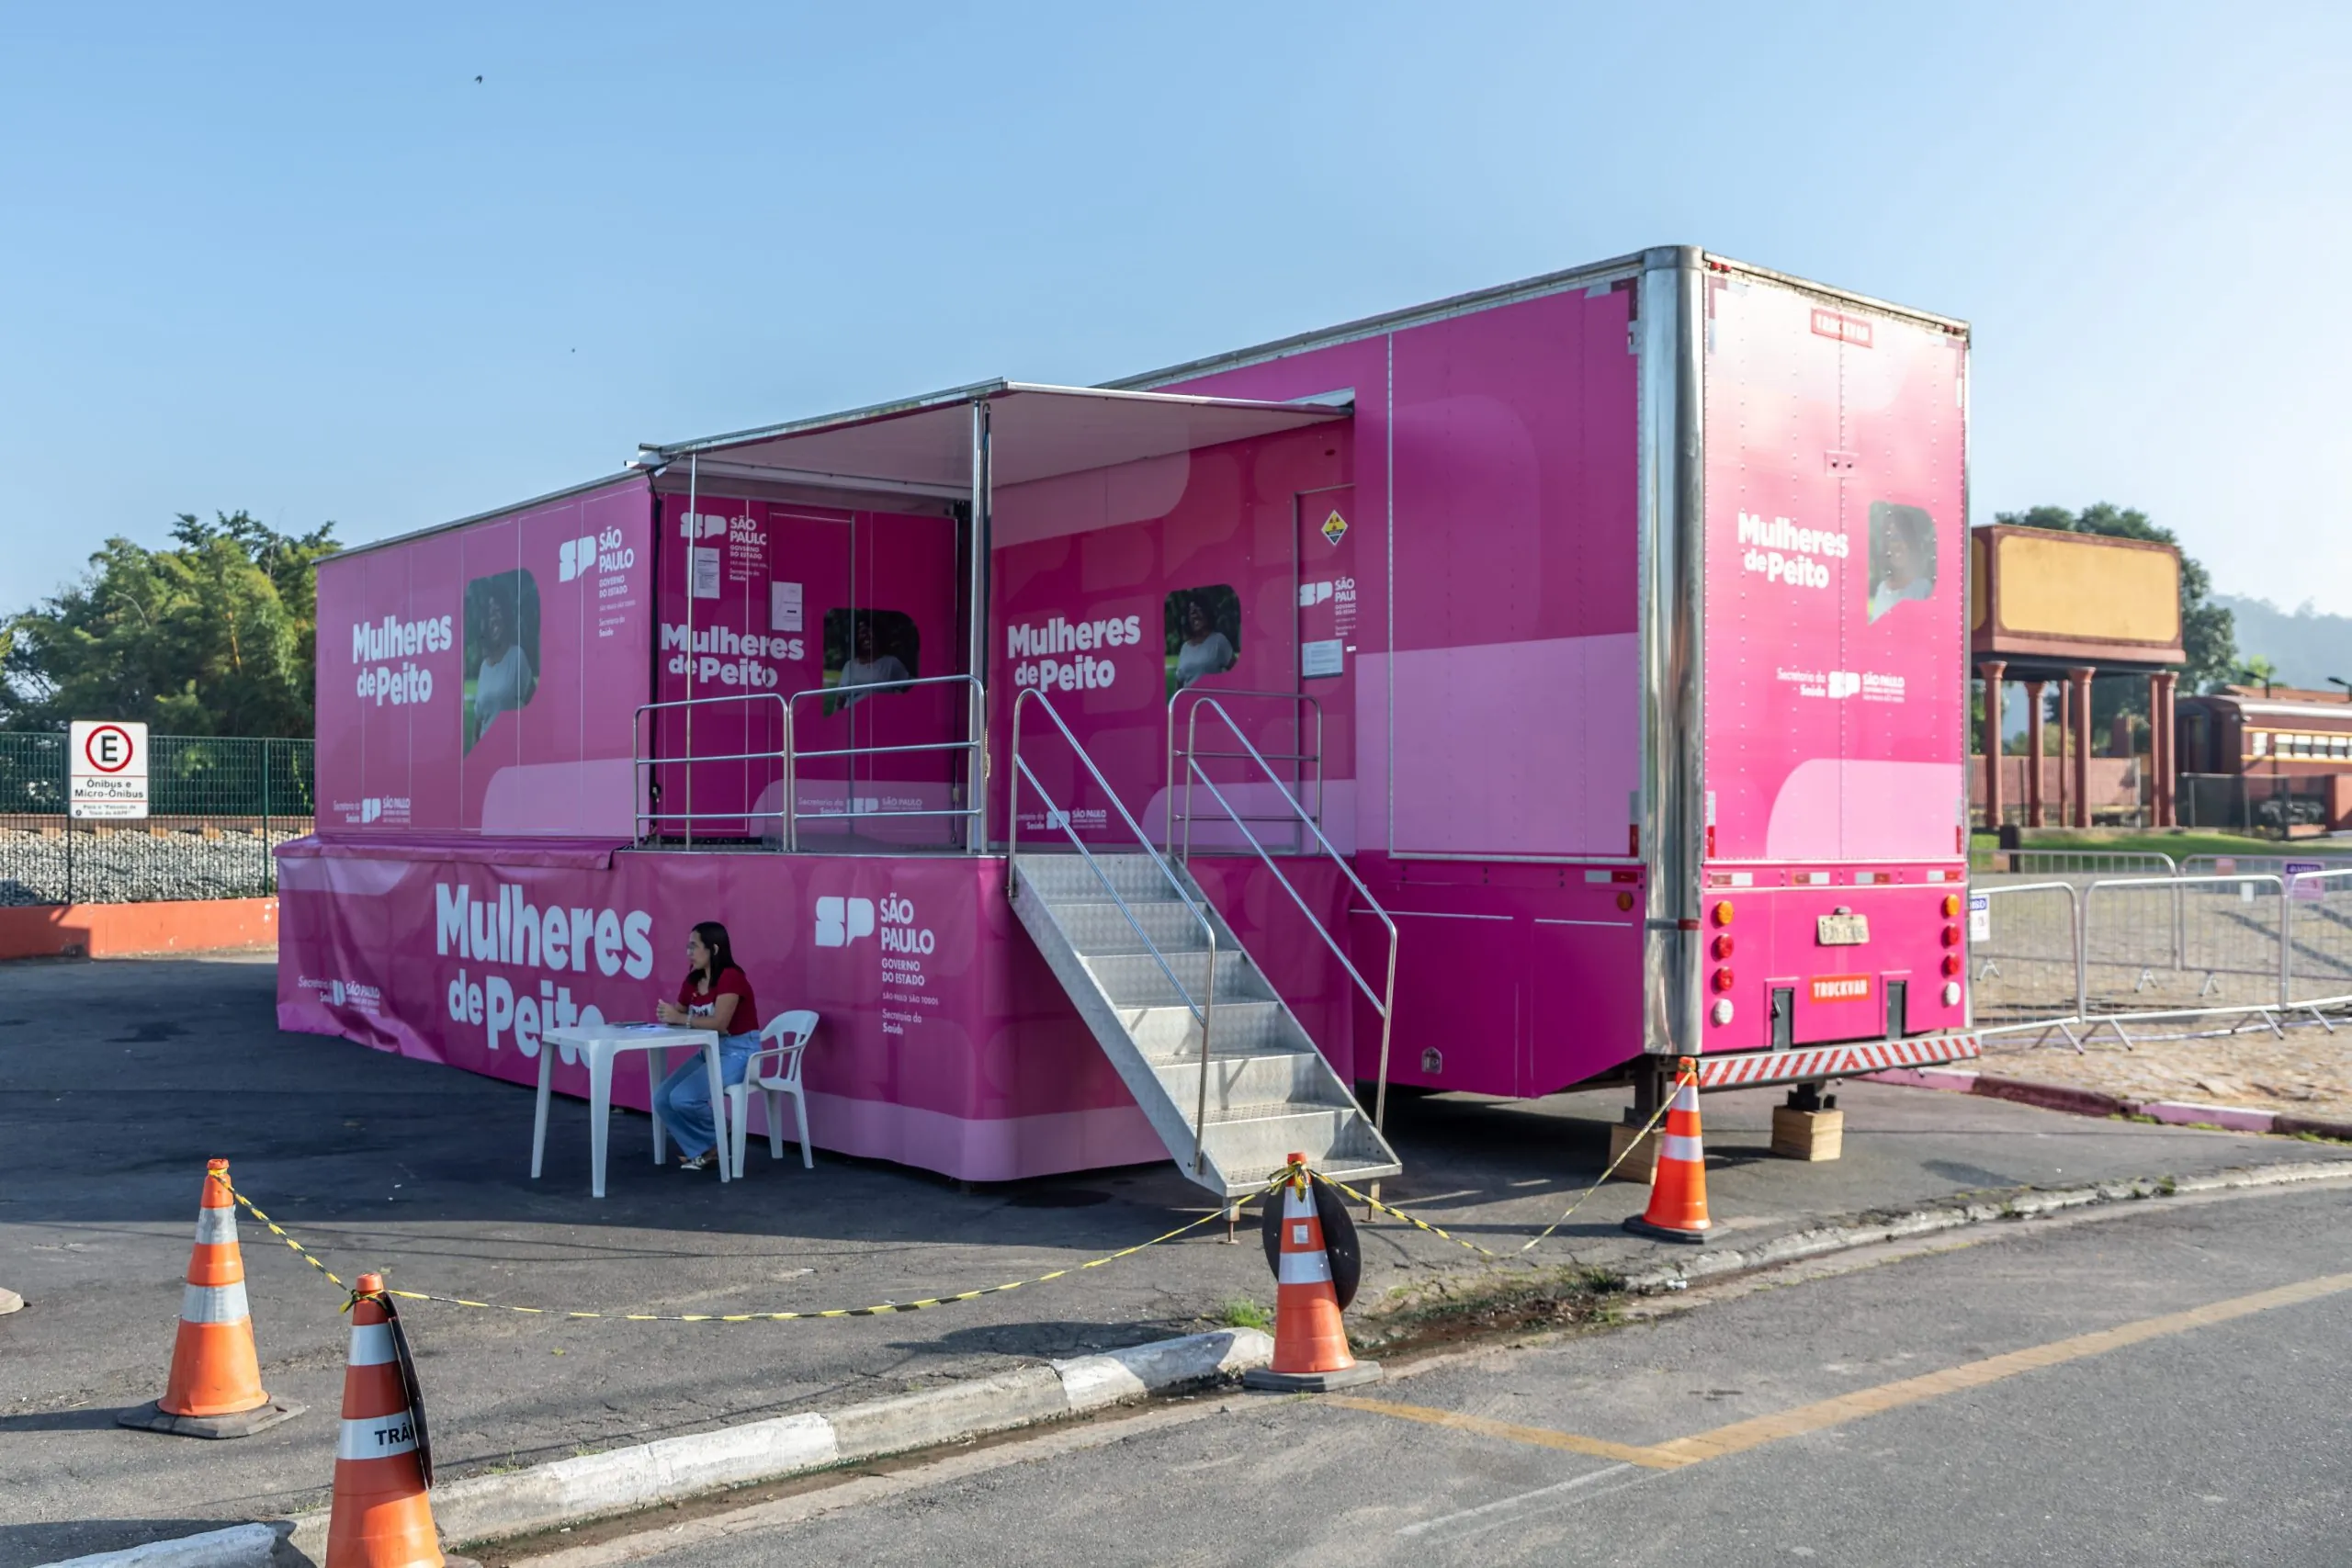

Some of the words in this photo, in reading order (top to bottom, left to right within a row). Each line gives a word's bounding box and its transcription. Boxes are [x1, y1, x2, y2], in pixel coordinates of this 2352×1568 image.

[729, 515, 756, 530] SÃO
[1737, 511, 1849, 558] Mulheres
[599, 525, 622, 552] SÃO
[599, 547, 634, 573] PAULO
[1744, 547, 1768, 572] de
[1767, 551, 1829, 589] Peito
[1335, 577, 1355, 592] SÃO
[353, 615, 452, 664] Mulheres
[661, 623, 805, 660] Mulheres
[1008, 615, 1141, 659] Mulheres
[356, 667, 376, 698] de
[376, 661, 433, 706] Peito
[668, 654, 698, 676] de
[699, 656, 779, 688] Peito
[1014, 661, 1039, 686] de
[1040, 654, 1115, 693] Peito
[101, 736, 118, 761] E
[74, 788, 143, 798] Micro-Ônibus
[86, 778, 122, 788] Ônibus
[882, 796, 898, 807] SÃO
[880, 892, 914, 924] SÃO
[435, 883, 653, 980] Mulheres
[881, 926, 935, 954] PAULO
[881, 957, 921, 972] GOVERNO
[345, 980, 360, 996] SÃO
[882, 972, 894, 983] DO
[895, 974, 925, 987] ESTADO
[1814, 979, 1868, 998] TRUCKVAN
[909, 995, 920, 1003] SÃO
[448, 968, 484, 1026] de
[486, 975, 605, 1069] Peito
[882, 1008, 911, 1022] Secretaria
[912, 1011, 922, 1023] da
[882, 1021, 904, 1035] Saúde
